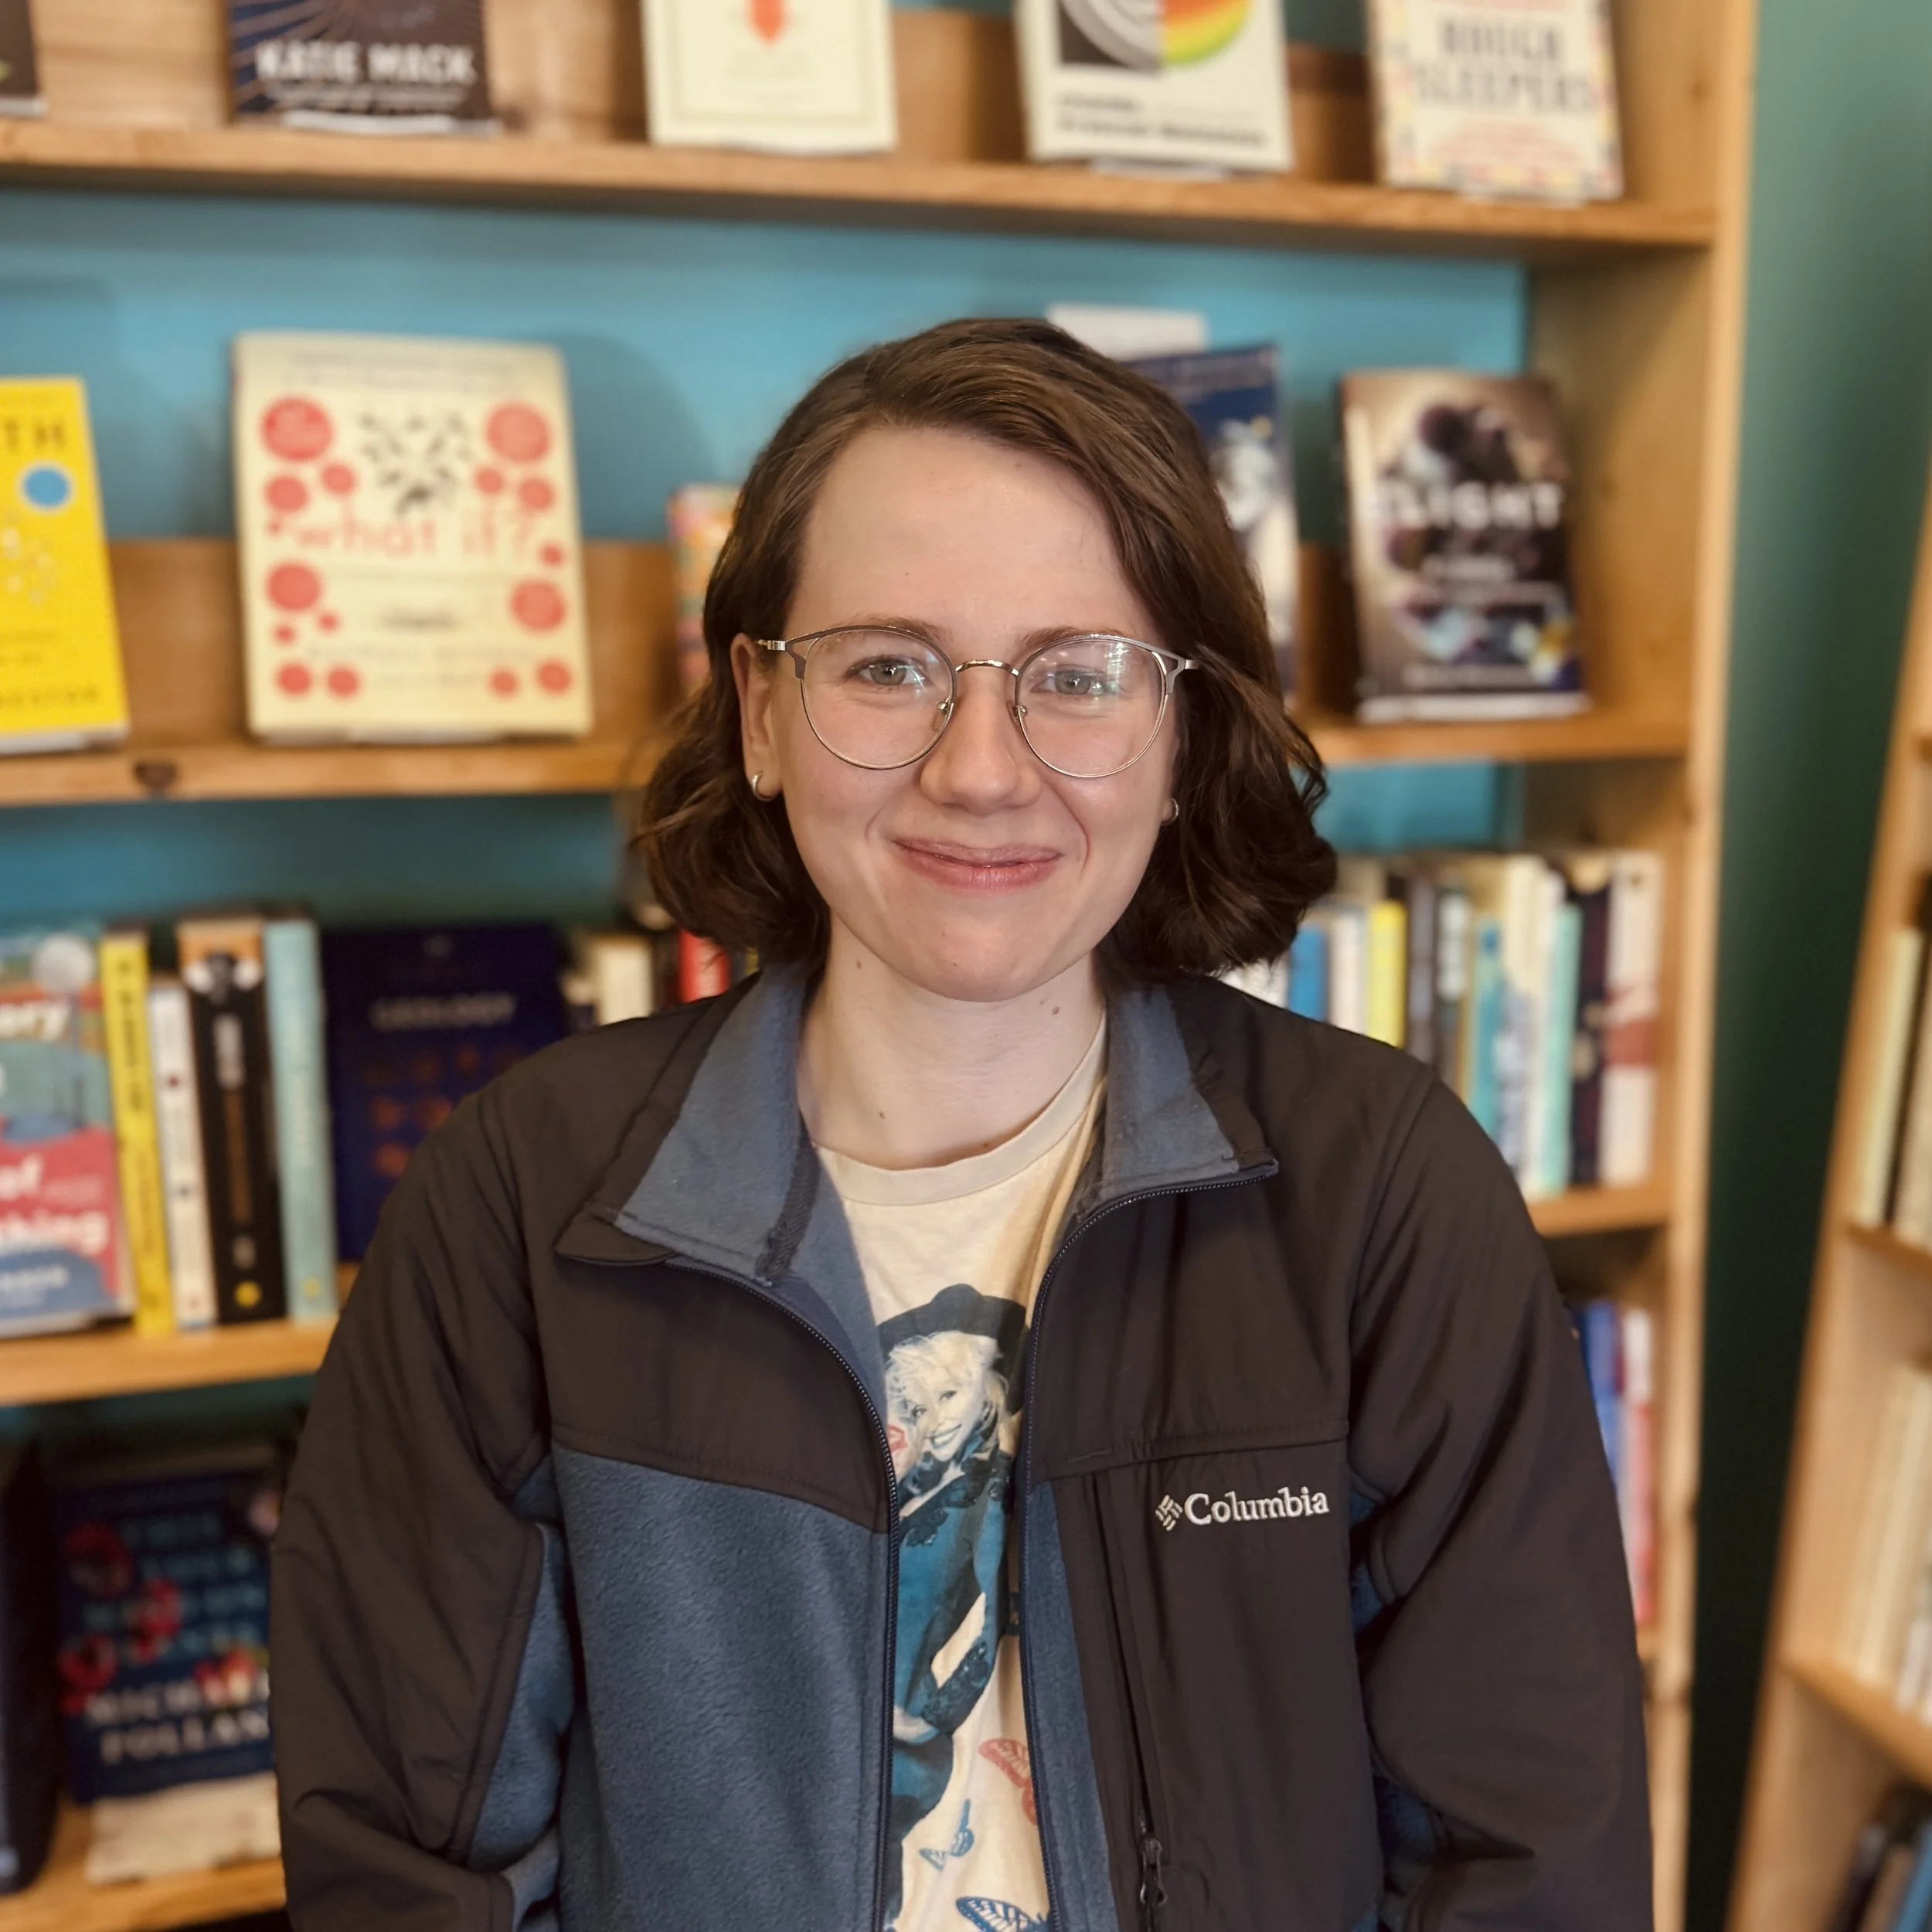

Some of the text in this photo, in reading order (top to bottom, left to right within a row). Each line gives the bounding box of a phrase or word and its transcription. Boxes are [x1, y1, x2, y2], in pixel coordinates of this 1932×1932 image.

[256, 39, 478, 86] KATIE MACK
[1184, 1485, 1330, 1526] Columbia
